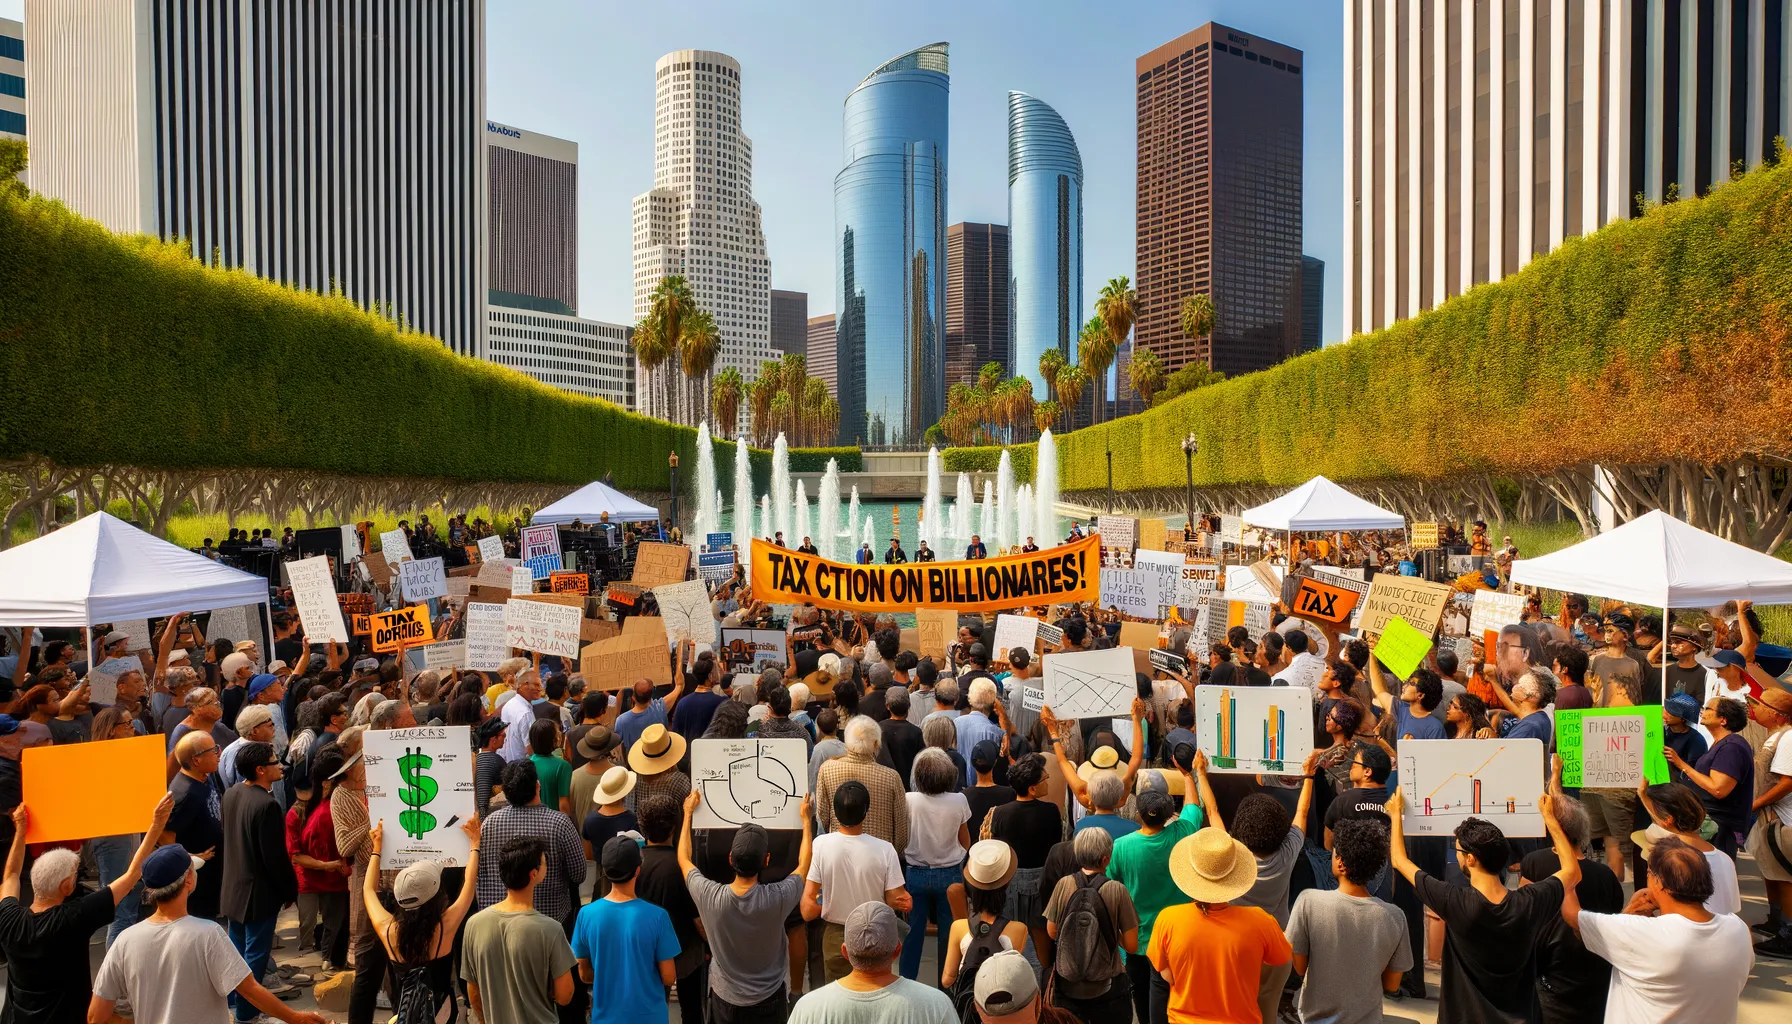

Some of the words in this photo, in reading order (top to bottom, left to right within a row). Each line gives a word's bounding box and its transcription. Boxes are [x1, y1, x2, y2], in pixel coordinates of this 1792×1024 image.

[769, 553, 811, 595] TAX
[815, 562, 885, 602] CTION
[890, 568, 923, 602] ON
[929, 551, 1086, 603] BILLIONARES!
[1302, 585, 1338, 617] TAX
[1606, 736, 1630, 752] INT
